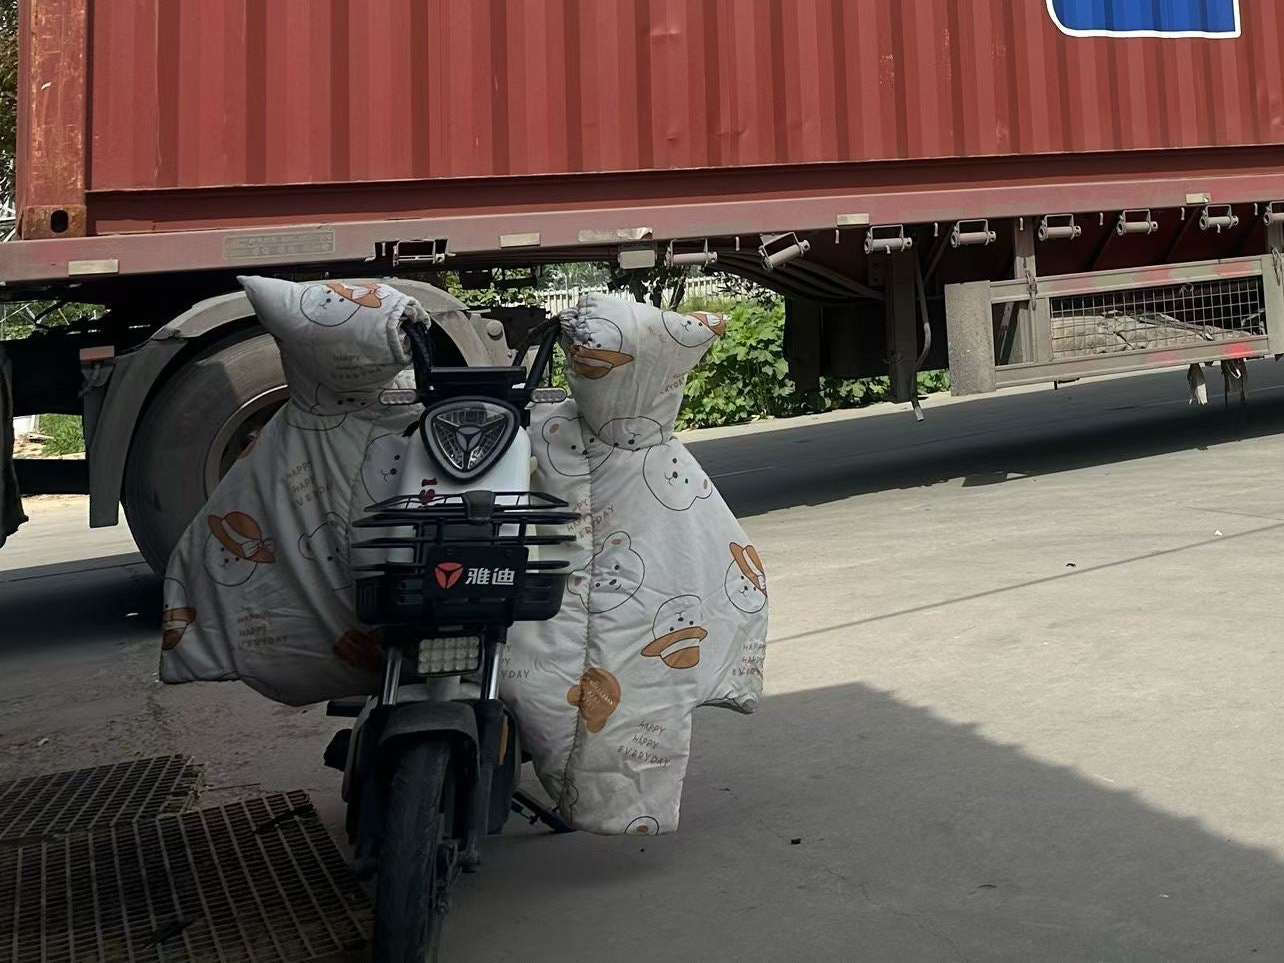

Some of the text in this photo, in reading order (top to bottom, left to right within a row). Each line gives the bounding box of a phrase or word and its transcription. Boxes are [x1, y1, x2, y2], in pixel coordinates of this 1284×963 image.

[465, 567, 515, 586] 雅迪
[632, 734, 660, 749] HAPPY
[616, 745, 672, 766] EVERYDAY
